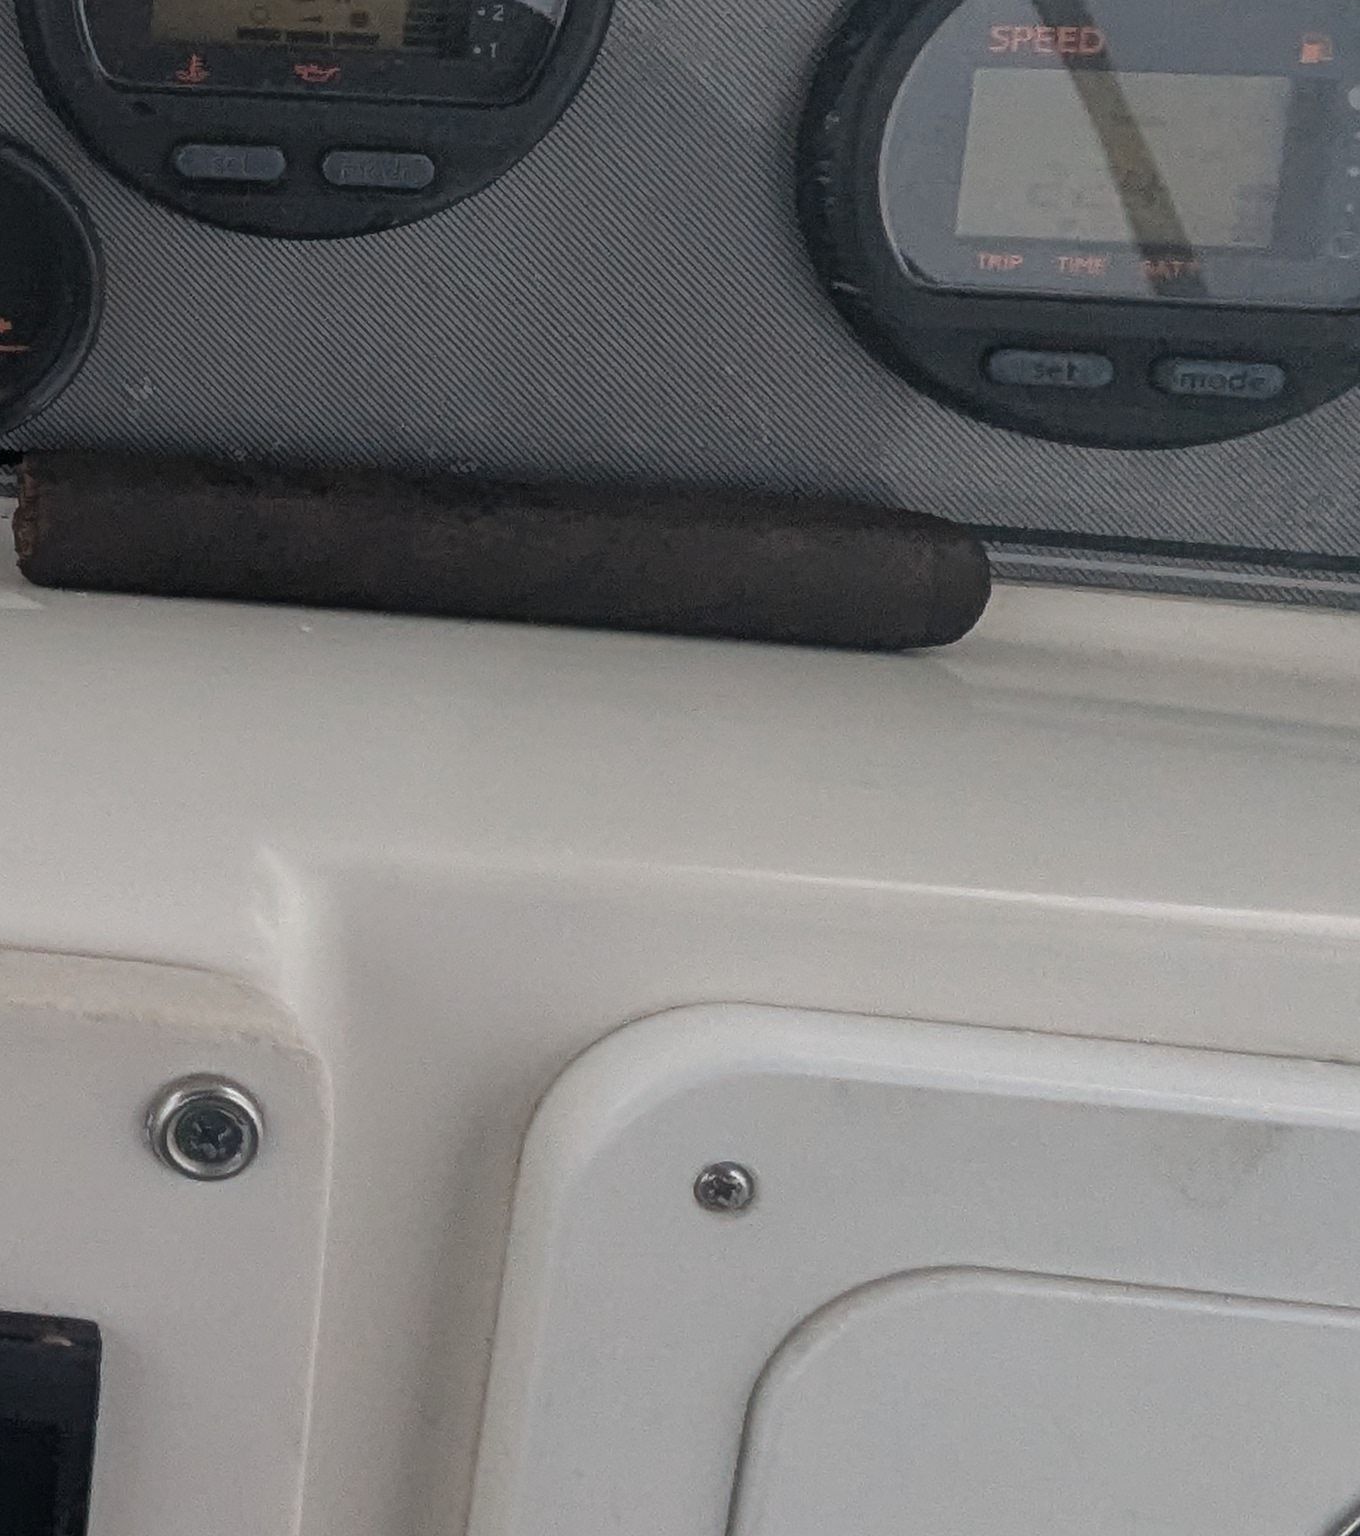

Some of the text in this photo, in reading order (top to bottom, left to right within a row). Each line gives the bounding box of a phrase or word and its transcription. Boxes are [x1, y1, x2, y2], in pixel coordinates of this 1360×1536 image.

[491, 4, 505, 21] 2
[488, 42, 497, 58] 1
[987, 25, 1107, 56] SPEED
[1179, 369, 1268, 392] mode
